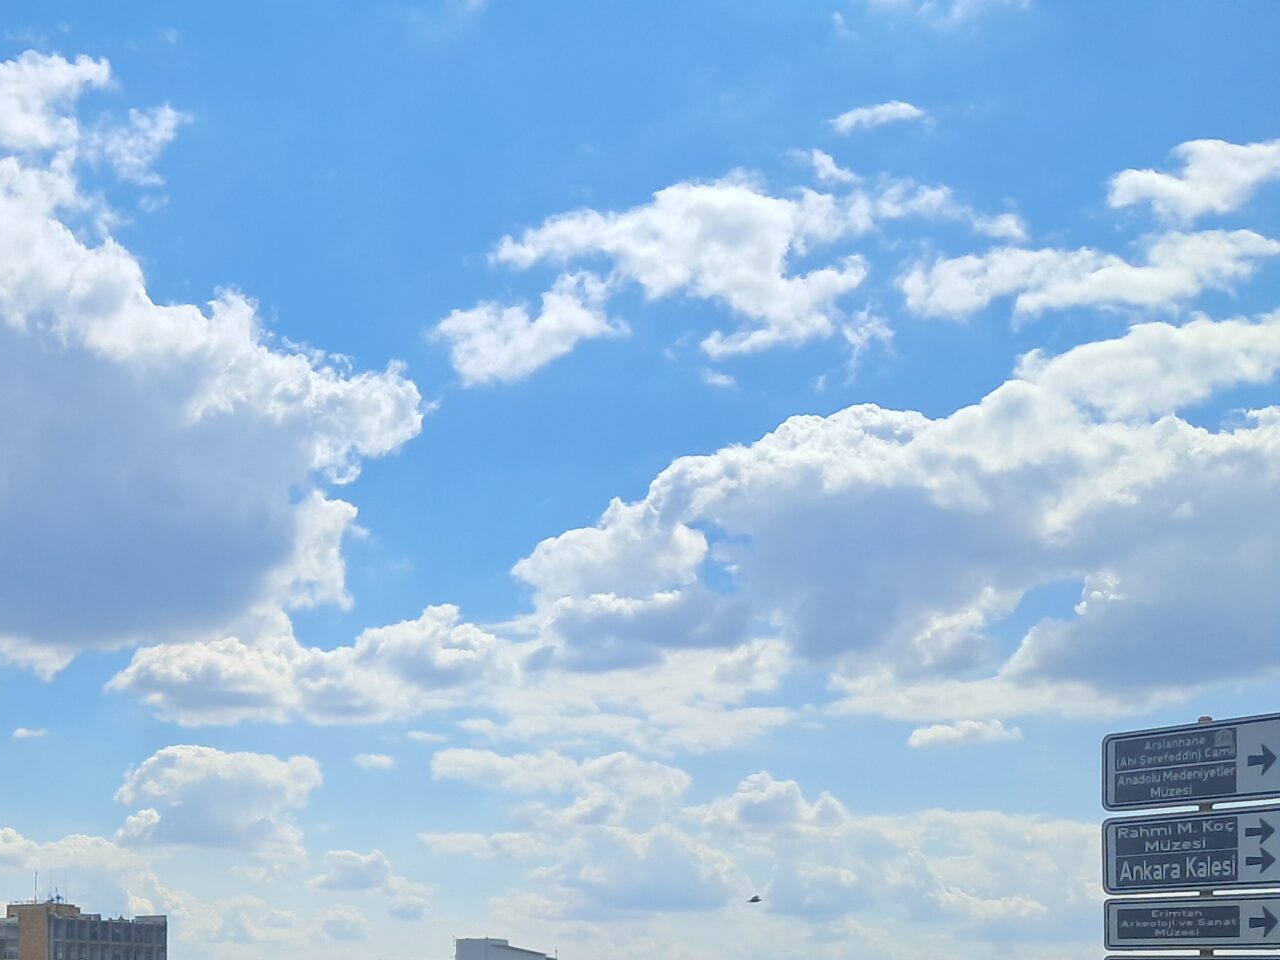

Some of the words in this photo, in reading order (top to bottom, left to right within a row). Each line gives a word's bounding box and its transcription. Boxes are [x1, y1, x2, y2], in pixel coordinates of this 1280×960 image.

[1144, 736, 1206, 751] Arslanhane
[1117, 773, 1160, 786] Anadolu
[1163, 766, 1236, 782] Medeniyetler
[1150, 785, 1193, 798] Müzesi
[1117, 825, 1172, 839] Rahmi
[1177, 821, 1198, 834] M.
[1202, 819, 1235, 834] Koç
[1144, 837, 1207, 853] Müzesi
[1119, 859, 1181, 882] Ankara
[1185, 853, 1236, 879] Kalesi
[1151, 910, 1202, 918] Erimtan
[1120, 920, 1175, 928] Arkeoloji
[1197, 918, 1237, 926] Sanat
[1154, 928, 1199, 937] Müzesi
